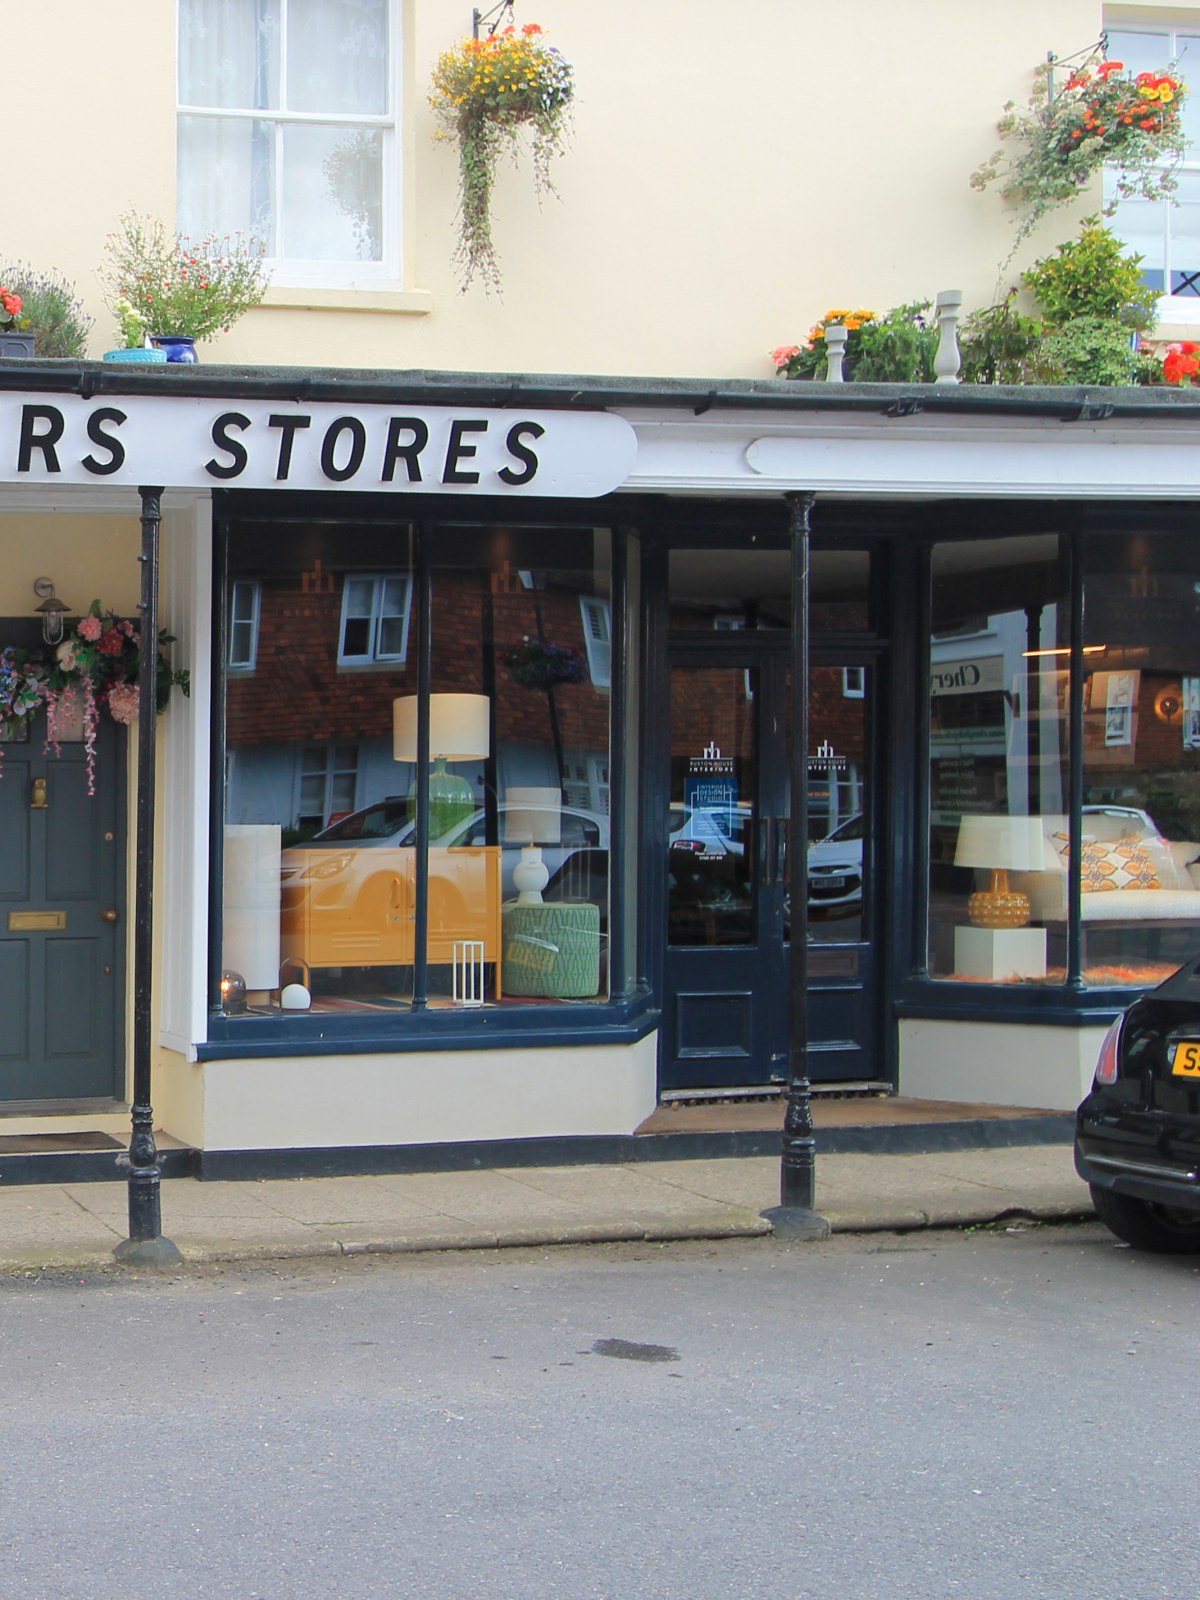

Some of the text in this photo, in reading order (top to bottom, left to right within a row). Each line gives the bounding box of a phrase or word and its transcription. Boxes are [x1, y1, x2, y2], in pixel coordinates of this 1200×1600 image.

[205, 412, 545, 486] STORES
[703, 741, 721, 759] rh
[817, 740, 834, 758] rh
